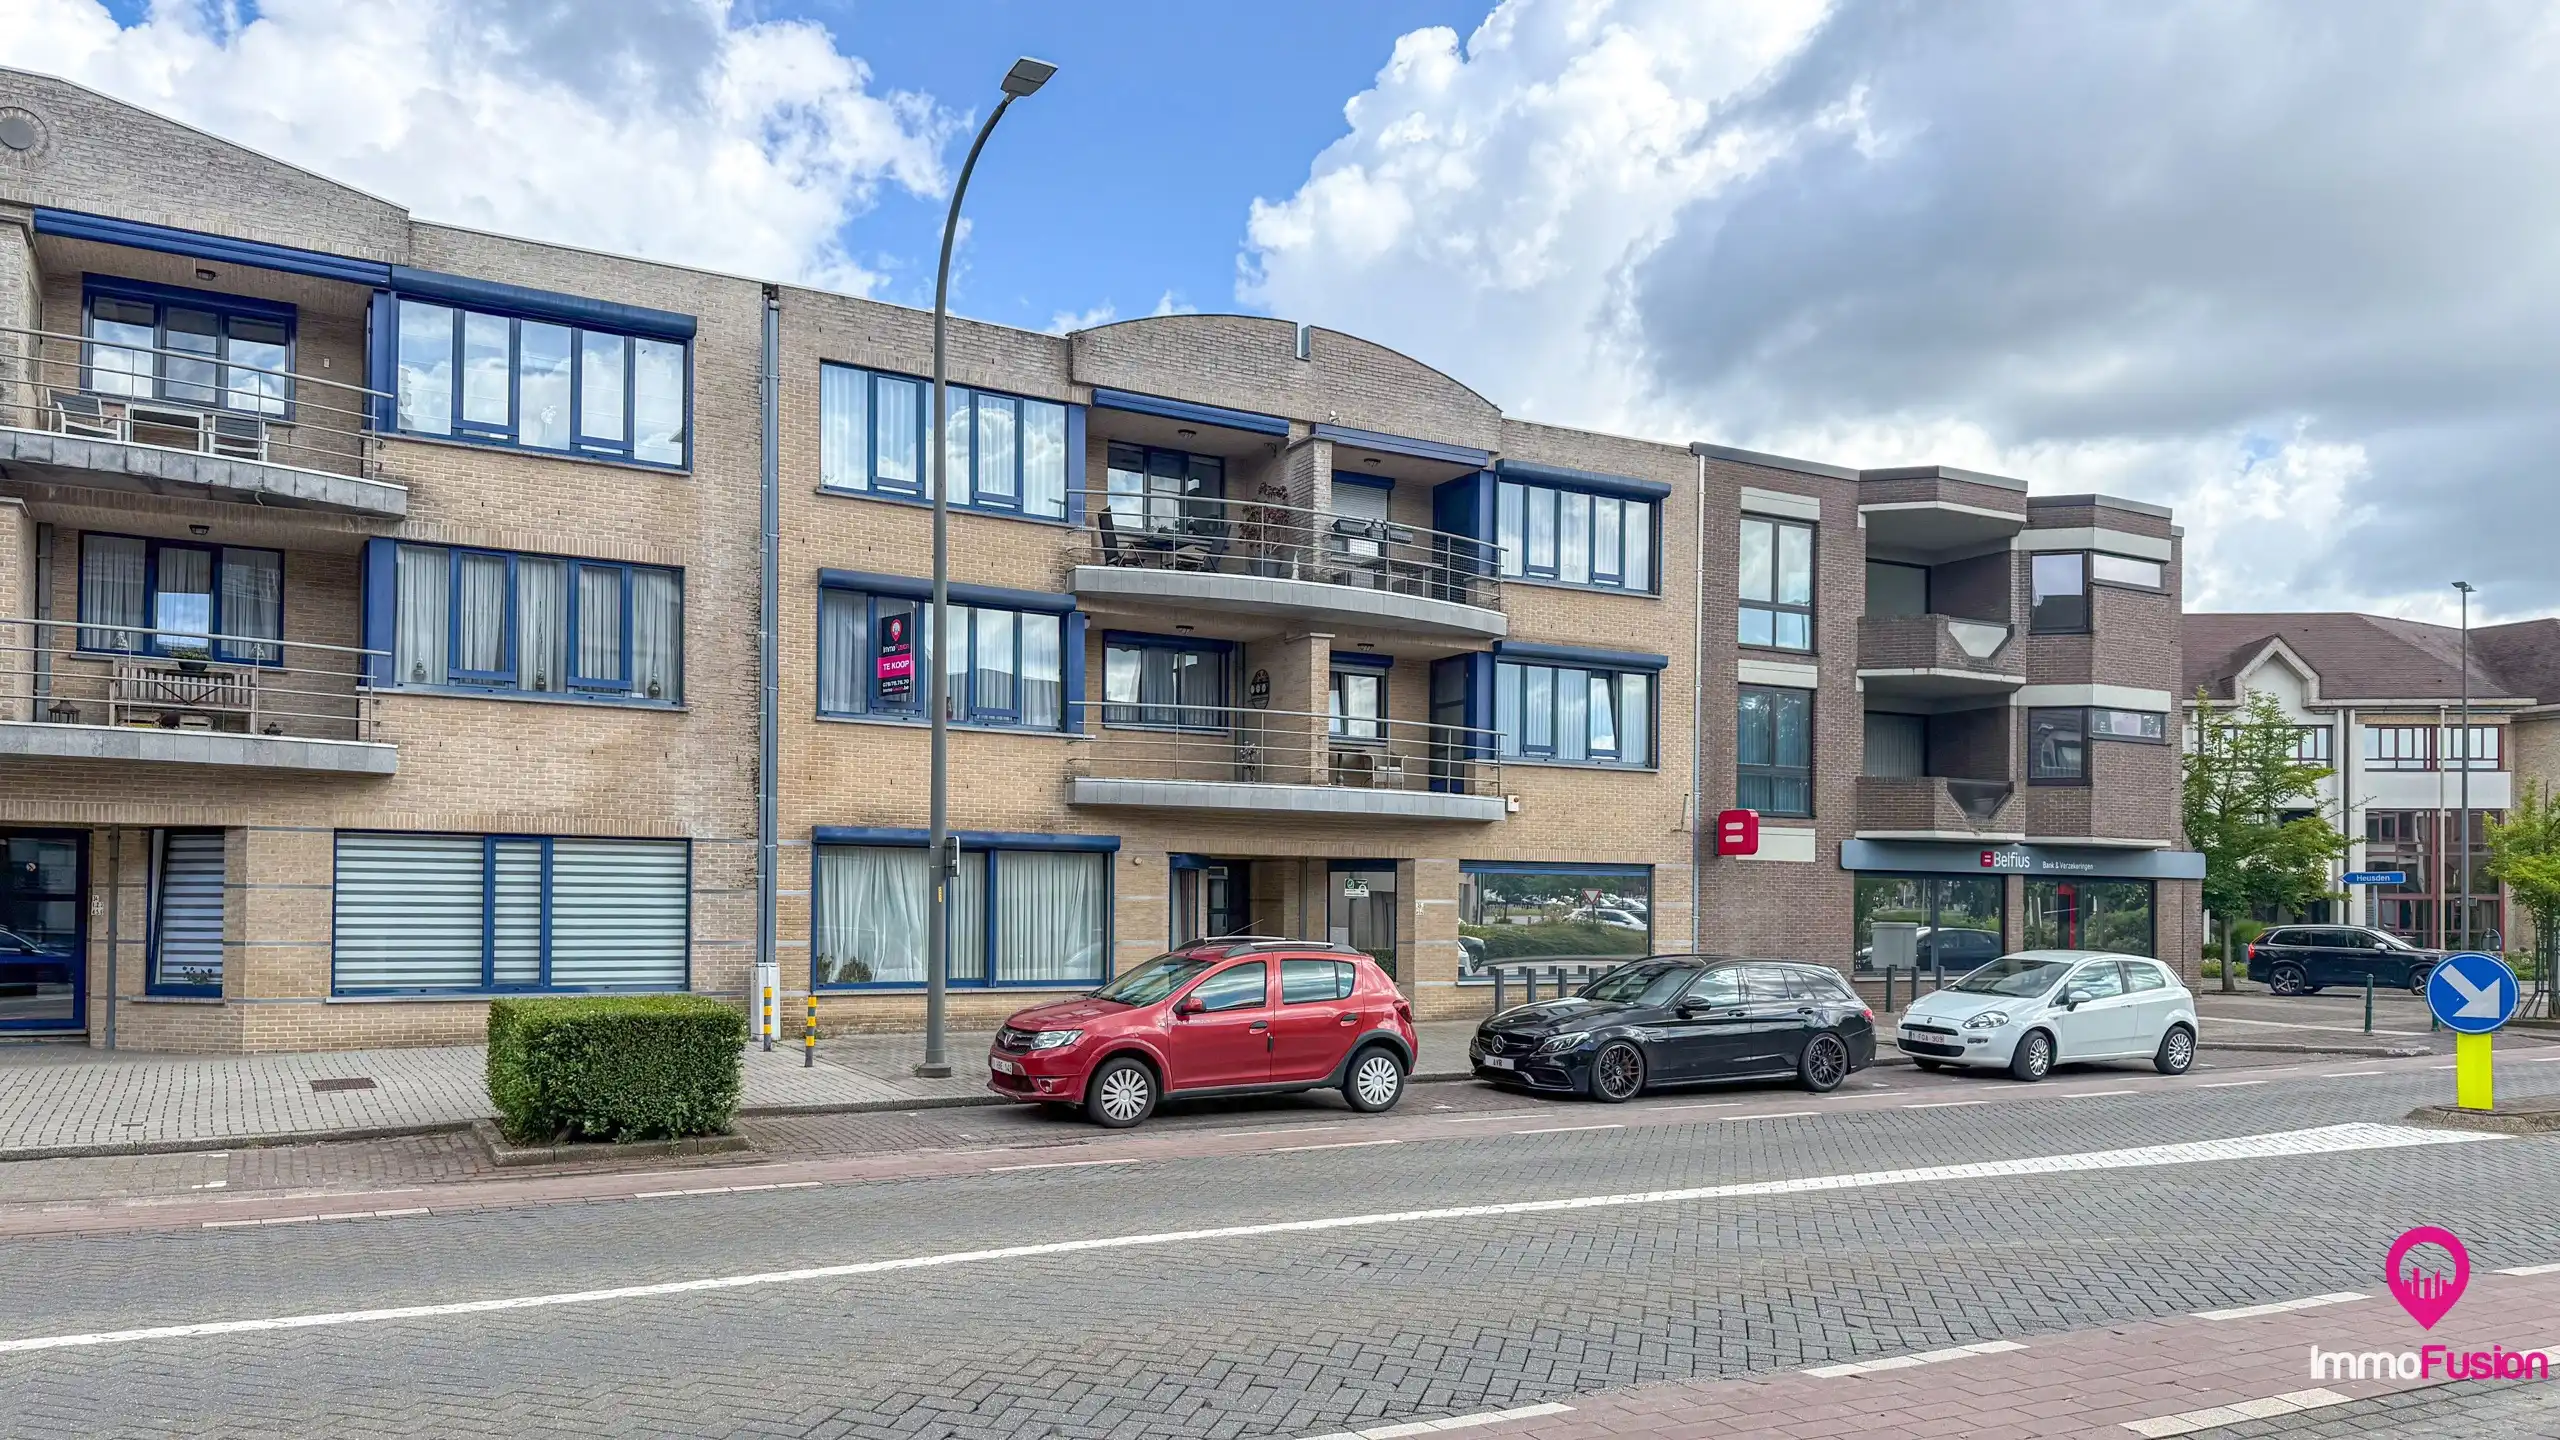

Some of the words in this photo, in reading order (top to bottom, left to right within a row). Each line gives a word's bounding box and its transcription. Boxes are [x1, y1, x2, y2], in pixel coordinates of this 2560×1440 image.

[883, 663, 890, 671] TE
[891, 660, 909, 670] KOOP
[1993, 851, 2031, 868] Belfius
[2042, 861, 2055, 869] Bank
[2060, 862, 2094, 871] Verzekeringen
[2356, 874, 2391, 882] Heusden
